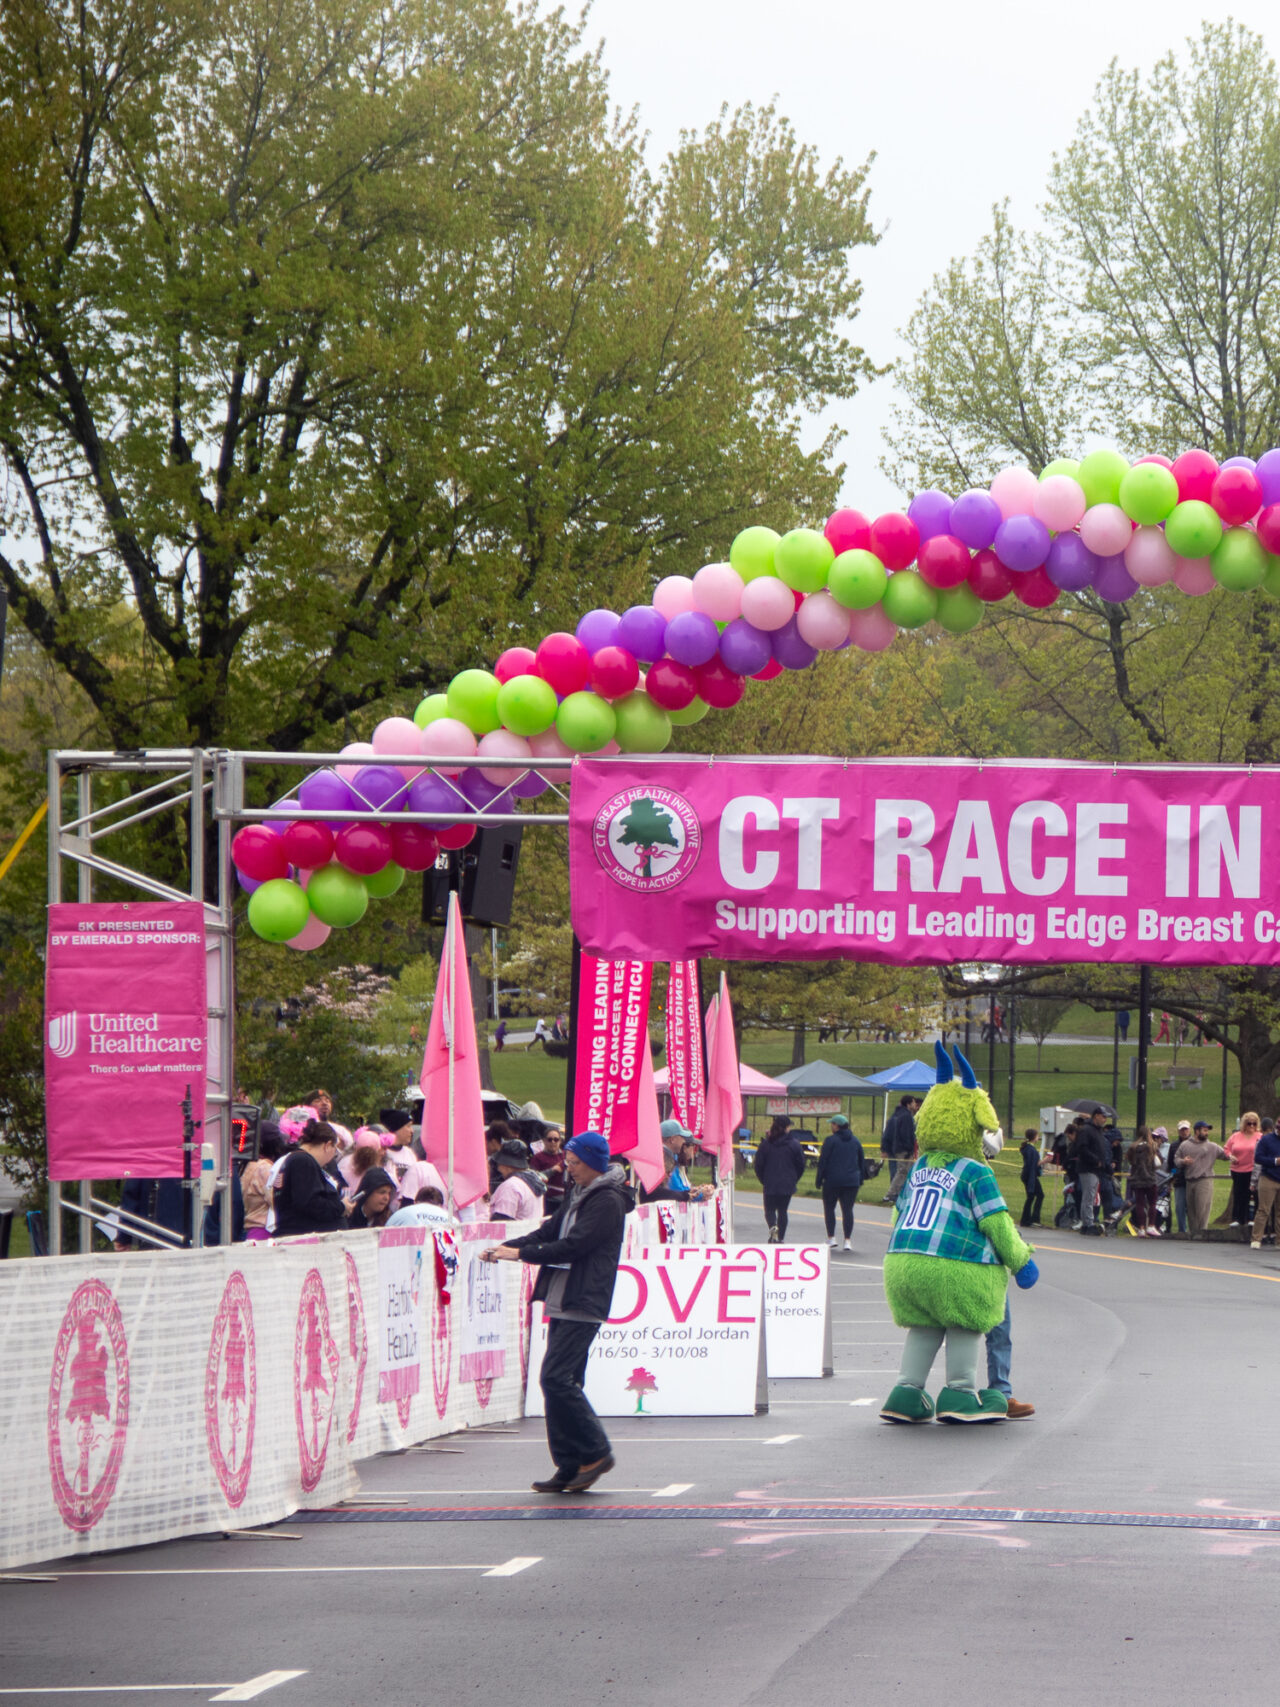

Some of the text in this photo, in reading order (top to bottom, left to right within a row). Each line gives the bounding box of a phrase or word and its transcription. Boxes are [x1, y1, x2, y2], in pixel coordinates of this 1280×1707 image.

[596, 789, 698, 848] CT BREAST HEALTH INITIATIVE
[718, 795, 840, 890] CT
[872, 799, 1129, 897] RACE
[1165, 803, 1262, 899] IN
[612, 866, 682, 888] HOPE in ACTION
[78, 920, 174, 931] 5K PRESENTED
[715, 900, 896, 942] Supporting
[907, 904, 1036, 945] Leading
[1046, 906, 1127, 946] Edge
[1137, 908, 1244, 943] Breast
[51, 933, 201, 945] BY EMERALD SPONSOR:
[88, 1013, 159, 1033] United
[620, 960, 643, 1081] CONNECTICU
[88, 1034, 202, 1054] Healthcare
[609, 999, 622, 1076] CANCER
[89, 1063, 202, 1073] There for what matters
[587, 1036, 606, 1131] PPORTING
[617, 1086, 630, 1104] IN
[541, 1264, 757, 1324] OVE
[790, 1288, 806, 1300] of
[774, 1305, 823, 1317] heroes.
[632, 1327, 649, 1340] of
[652, 1327, 692, 1340] Carol
[695, 1327, 750, 1340] Jordan
[589, 1346, 638, 1359] /16/50
[651, 1346, 709, 1359] 3/10/08
